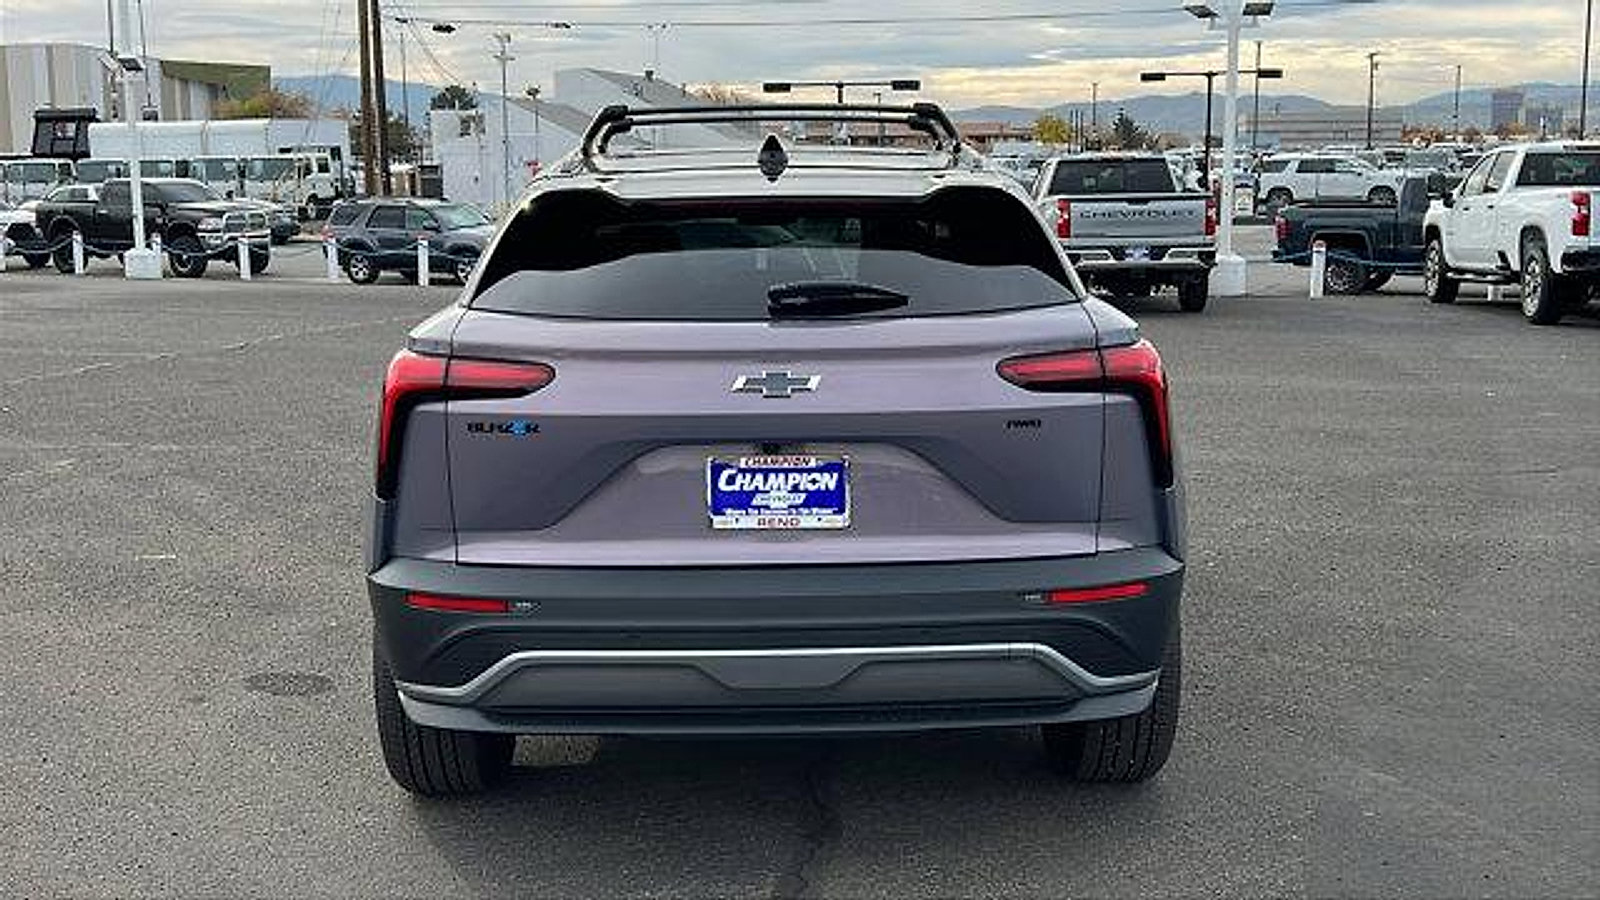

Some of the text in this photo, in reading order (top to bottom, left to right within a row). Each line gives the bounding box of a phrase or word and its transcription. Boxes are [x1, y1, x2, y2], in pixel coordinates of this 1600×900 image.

[1079, 208, 1195, 219] CHEVROLET
[718, 469, 838, 491] CHAMPION
[757, 517, 801, 527] RENO
